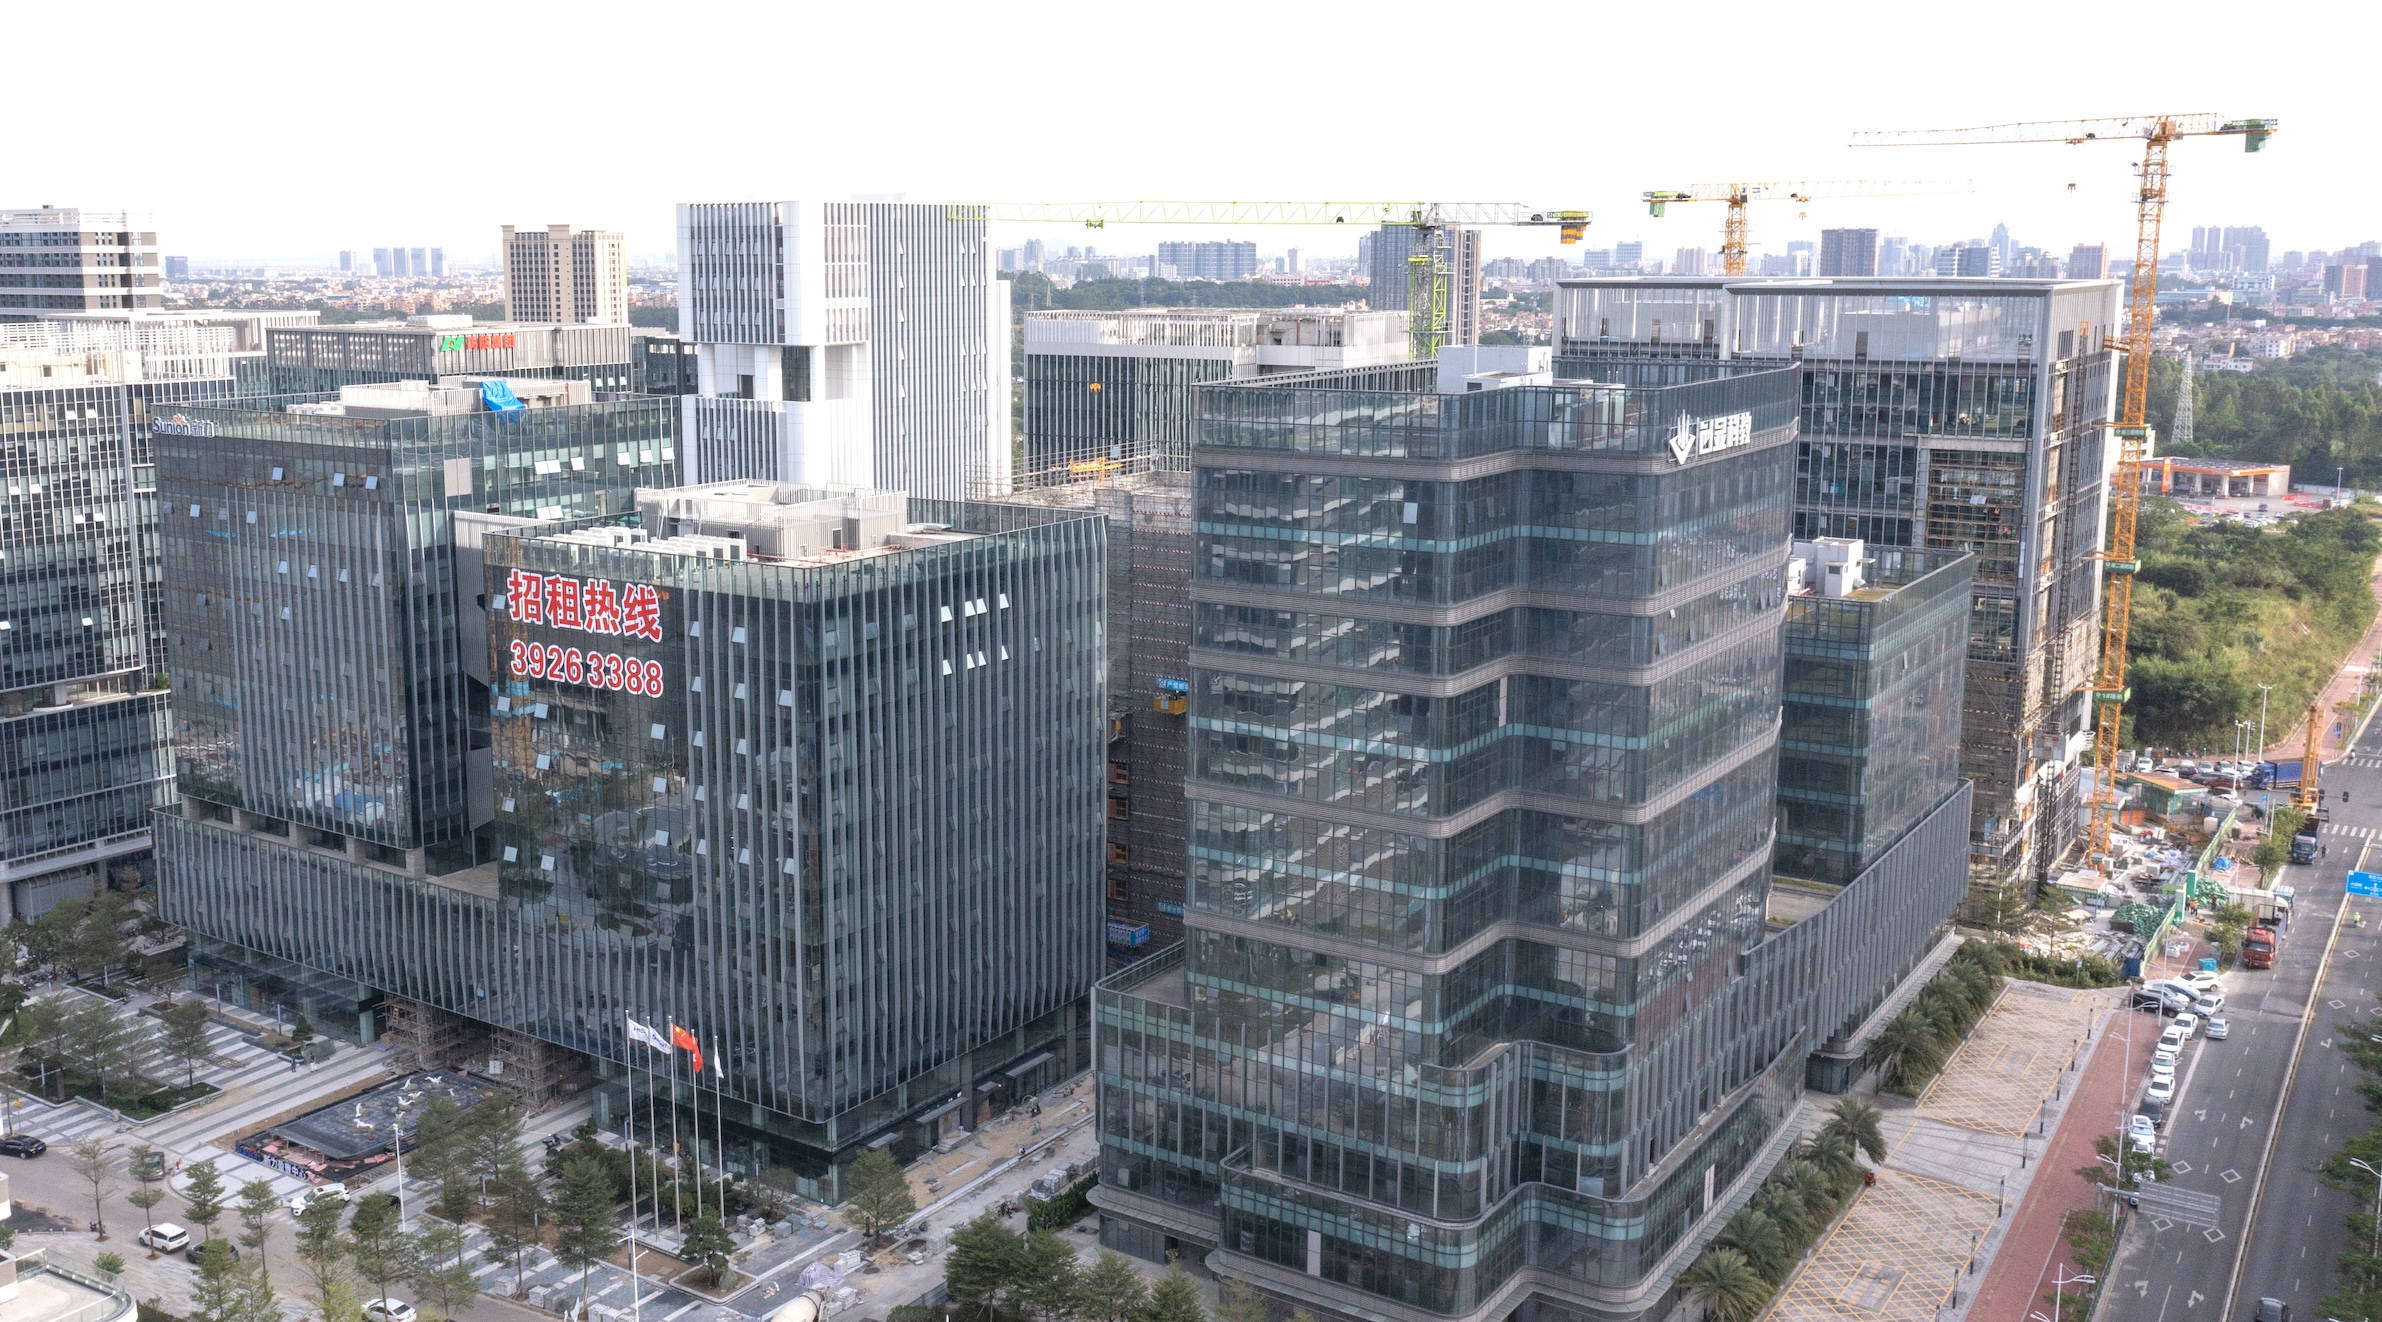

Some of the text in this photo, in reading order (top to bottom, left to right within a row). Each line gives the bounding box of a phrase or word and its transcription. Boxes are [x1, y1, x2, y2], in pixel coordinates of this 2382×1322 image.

[152, 417, 191, 436] Sunion
[507, 568, 662, 642] 招租热线
[511, 640, 664, 698] 39263388
